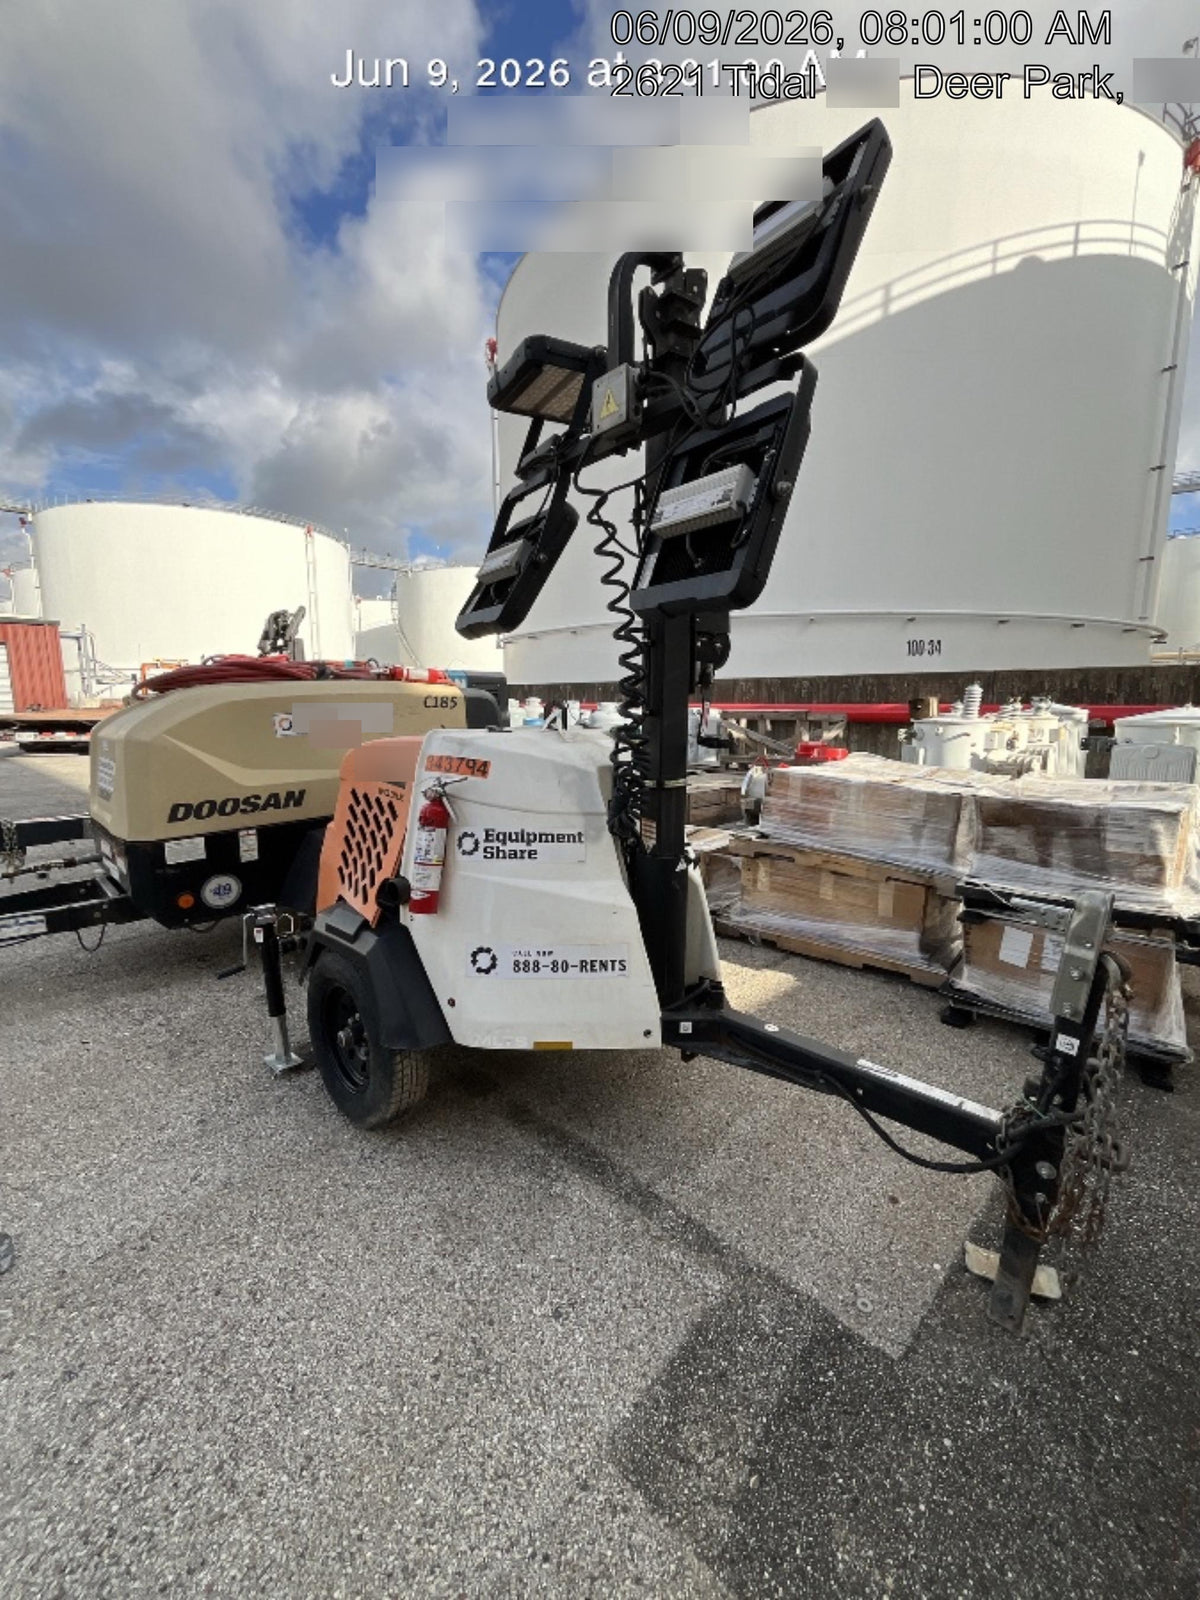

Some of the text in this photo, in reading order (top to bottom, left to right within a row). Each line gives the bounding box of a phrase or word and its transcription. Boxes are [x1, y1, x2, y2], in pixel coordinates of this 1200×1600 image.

[423, 694, 459, 710] C185
[167, 789, 307, 824] DOOSAN
[483, 828, 585, 845] Equipment
[483, 845, 538, 860] Share
[512, 958, 628, 974] 888-80-RENTS
